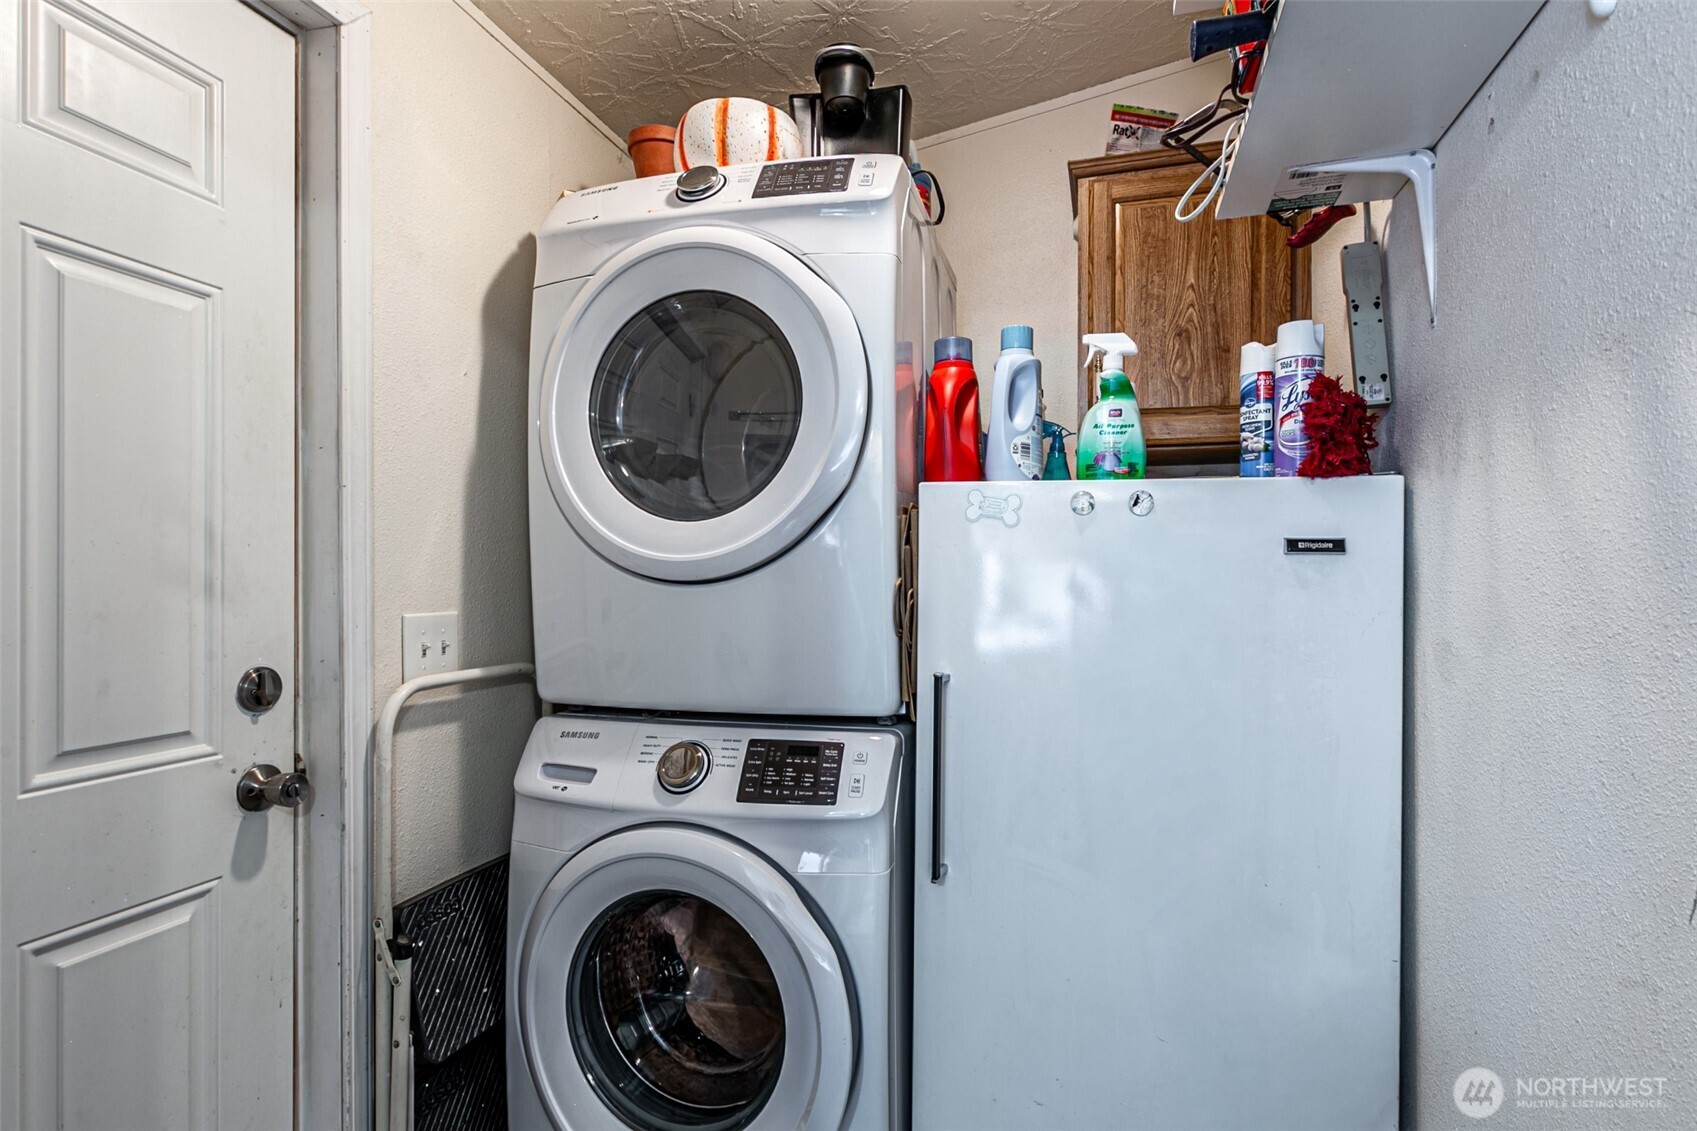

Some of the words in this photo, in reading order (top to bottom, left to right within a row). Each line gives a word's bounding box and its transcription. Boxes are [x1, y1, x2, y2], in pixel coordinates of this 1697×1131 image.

[1294, 357, 1315, 369] 100
[1281, 383, 1311, 411] Lys
[1243, 414, 1259, 422] SPRAY
[1304, 541, 1333, 550] Frigidaire
[560, 731, 600, 740] SAMSUNG
